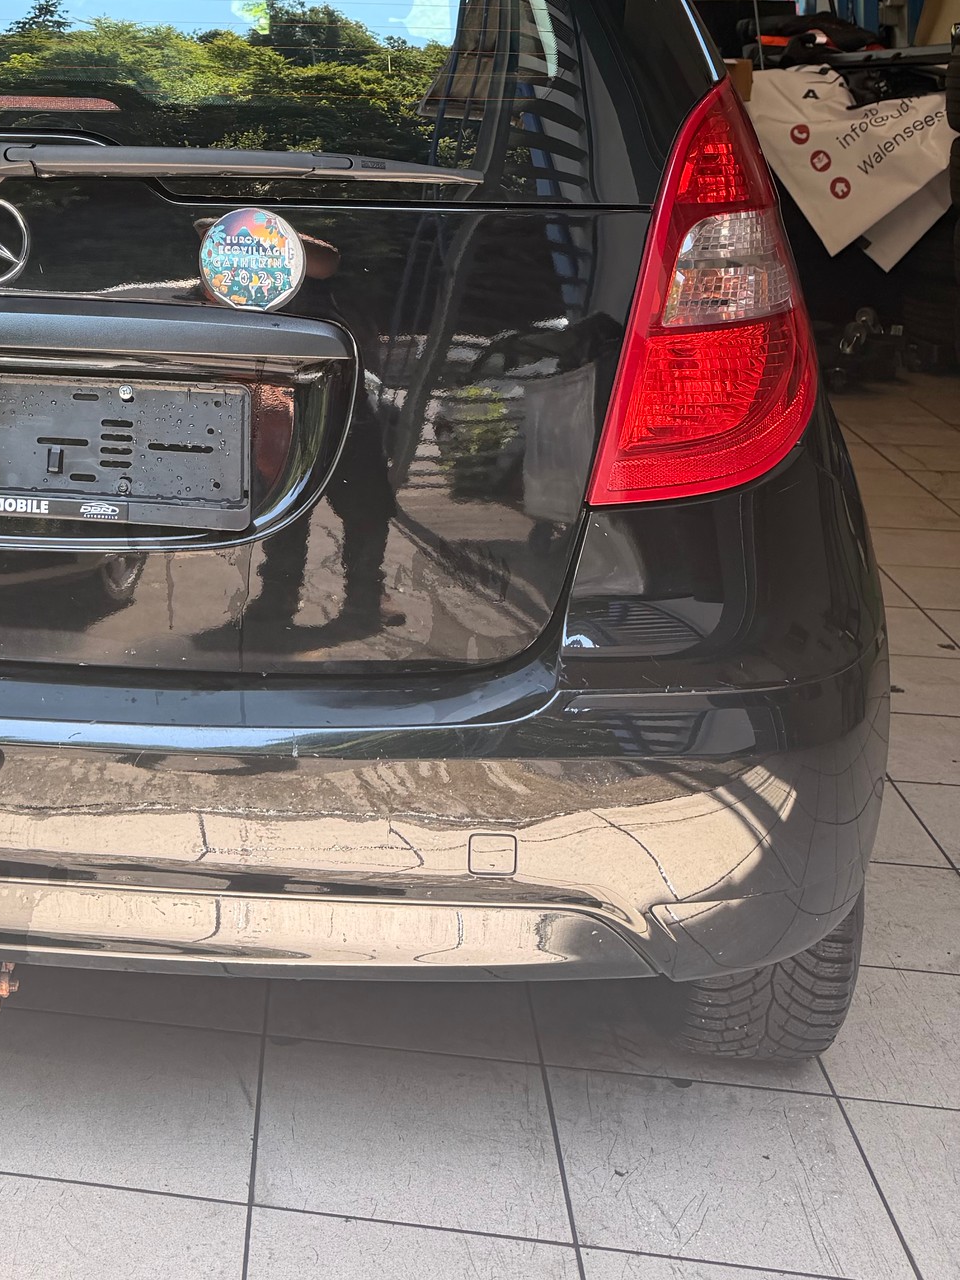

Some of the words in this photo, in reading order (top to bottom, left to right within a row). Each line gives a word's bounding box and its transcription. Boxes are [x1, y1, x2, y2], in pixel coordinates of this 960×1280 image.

[857, 110, 947, 175] Walensees
[226, 235, 279, 245] EUROPEAN
[220, 270, 284, 286] 2023
